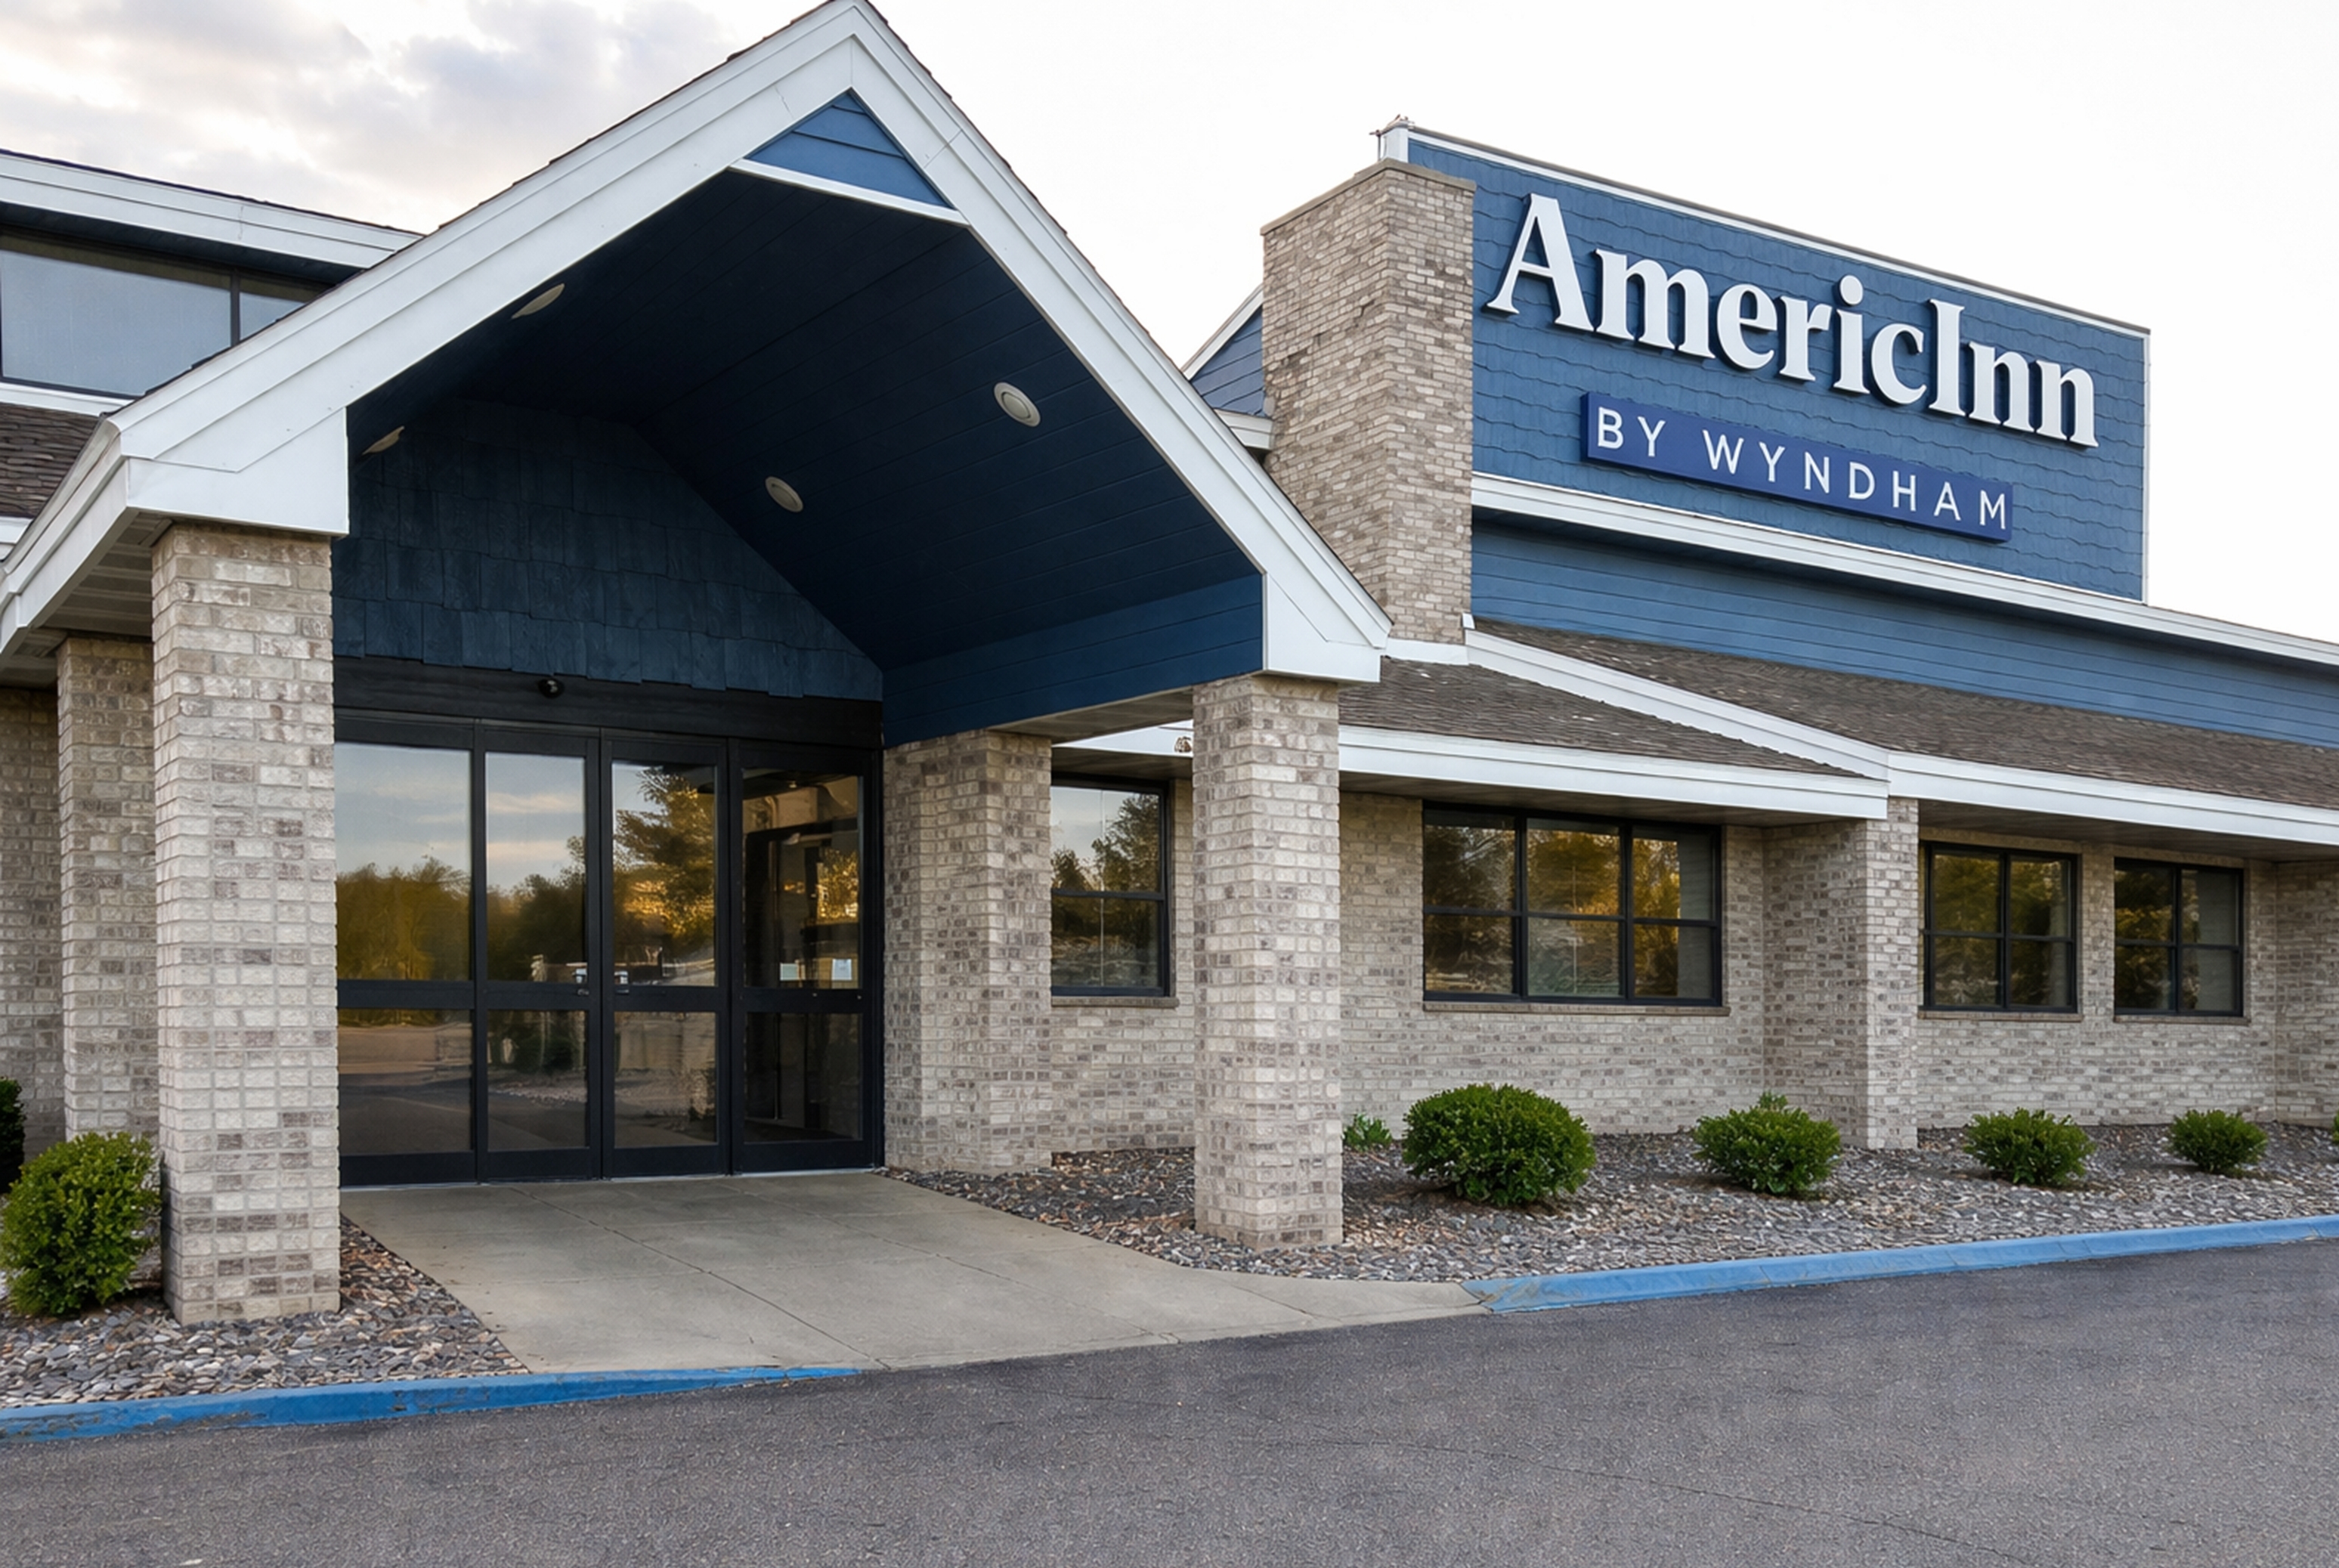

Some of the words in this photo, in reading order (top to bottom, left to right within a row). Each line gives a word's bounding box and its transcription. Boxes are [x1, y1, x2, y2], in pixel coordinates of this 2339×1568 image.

[1485, 192, 2099, 448] AmericInn
[1597, 407, 1666, 457] BY
[1702, 428, 2006, 530] WYNDHAM
